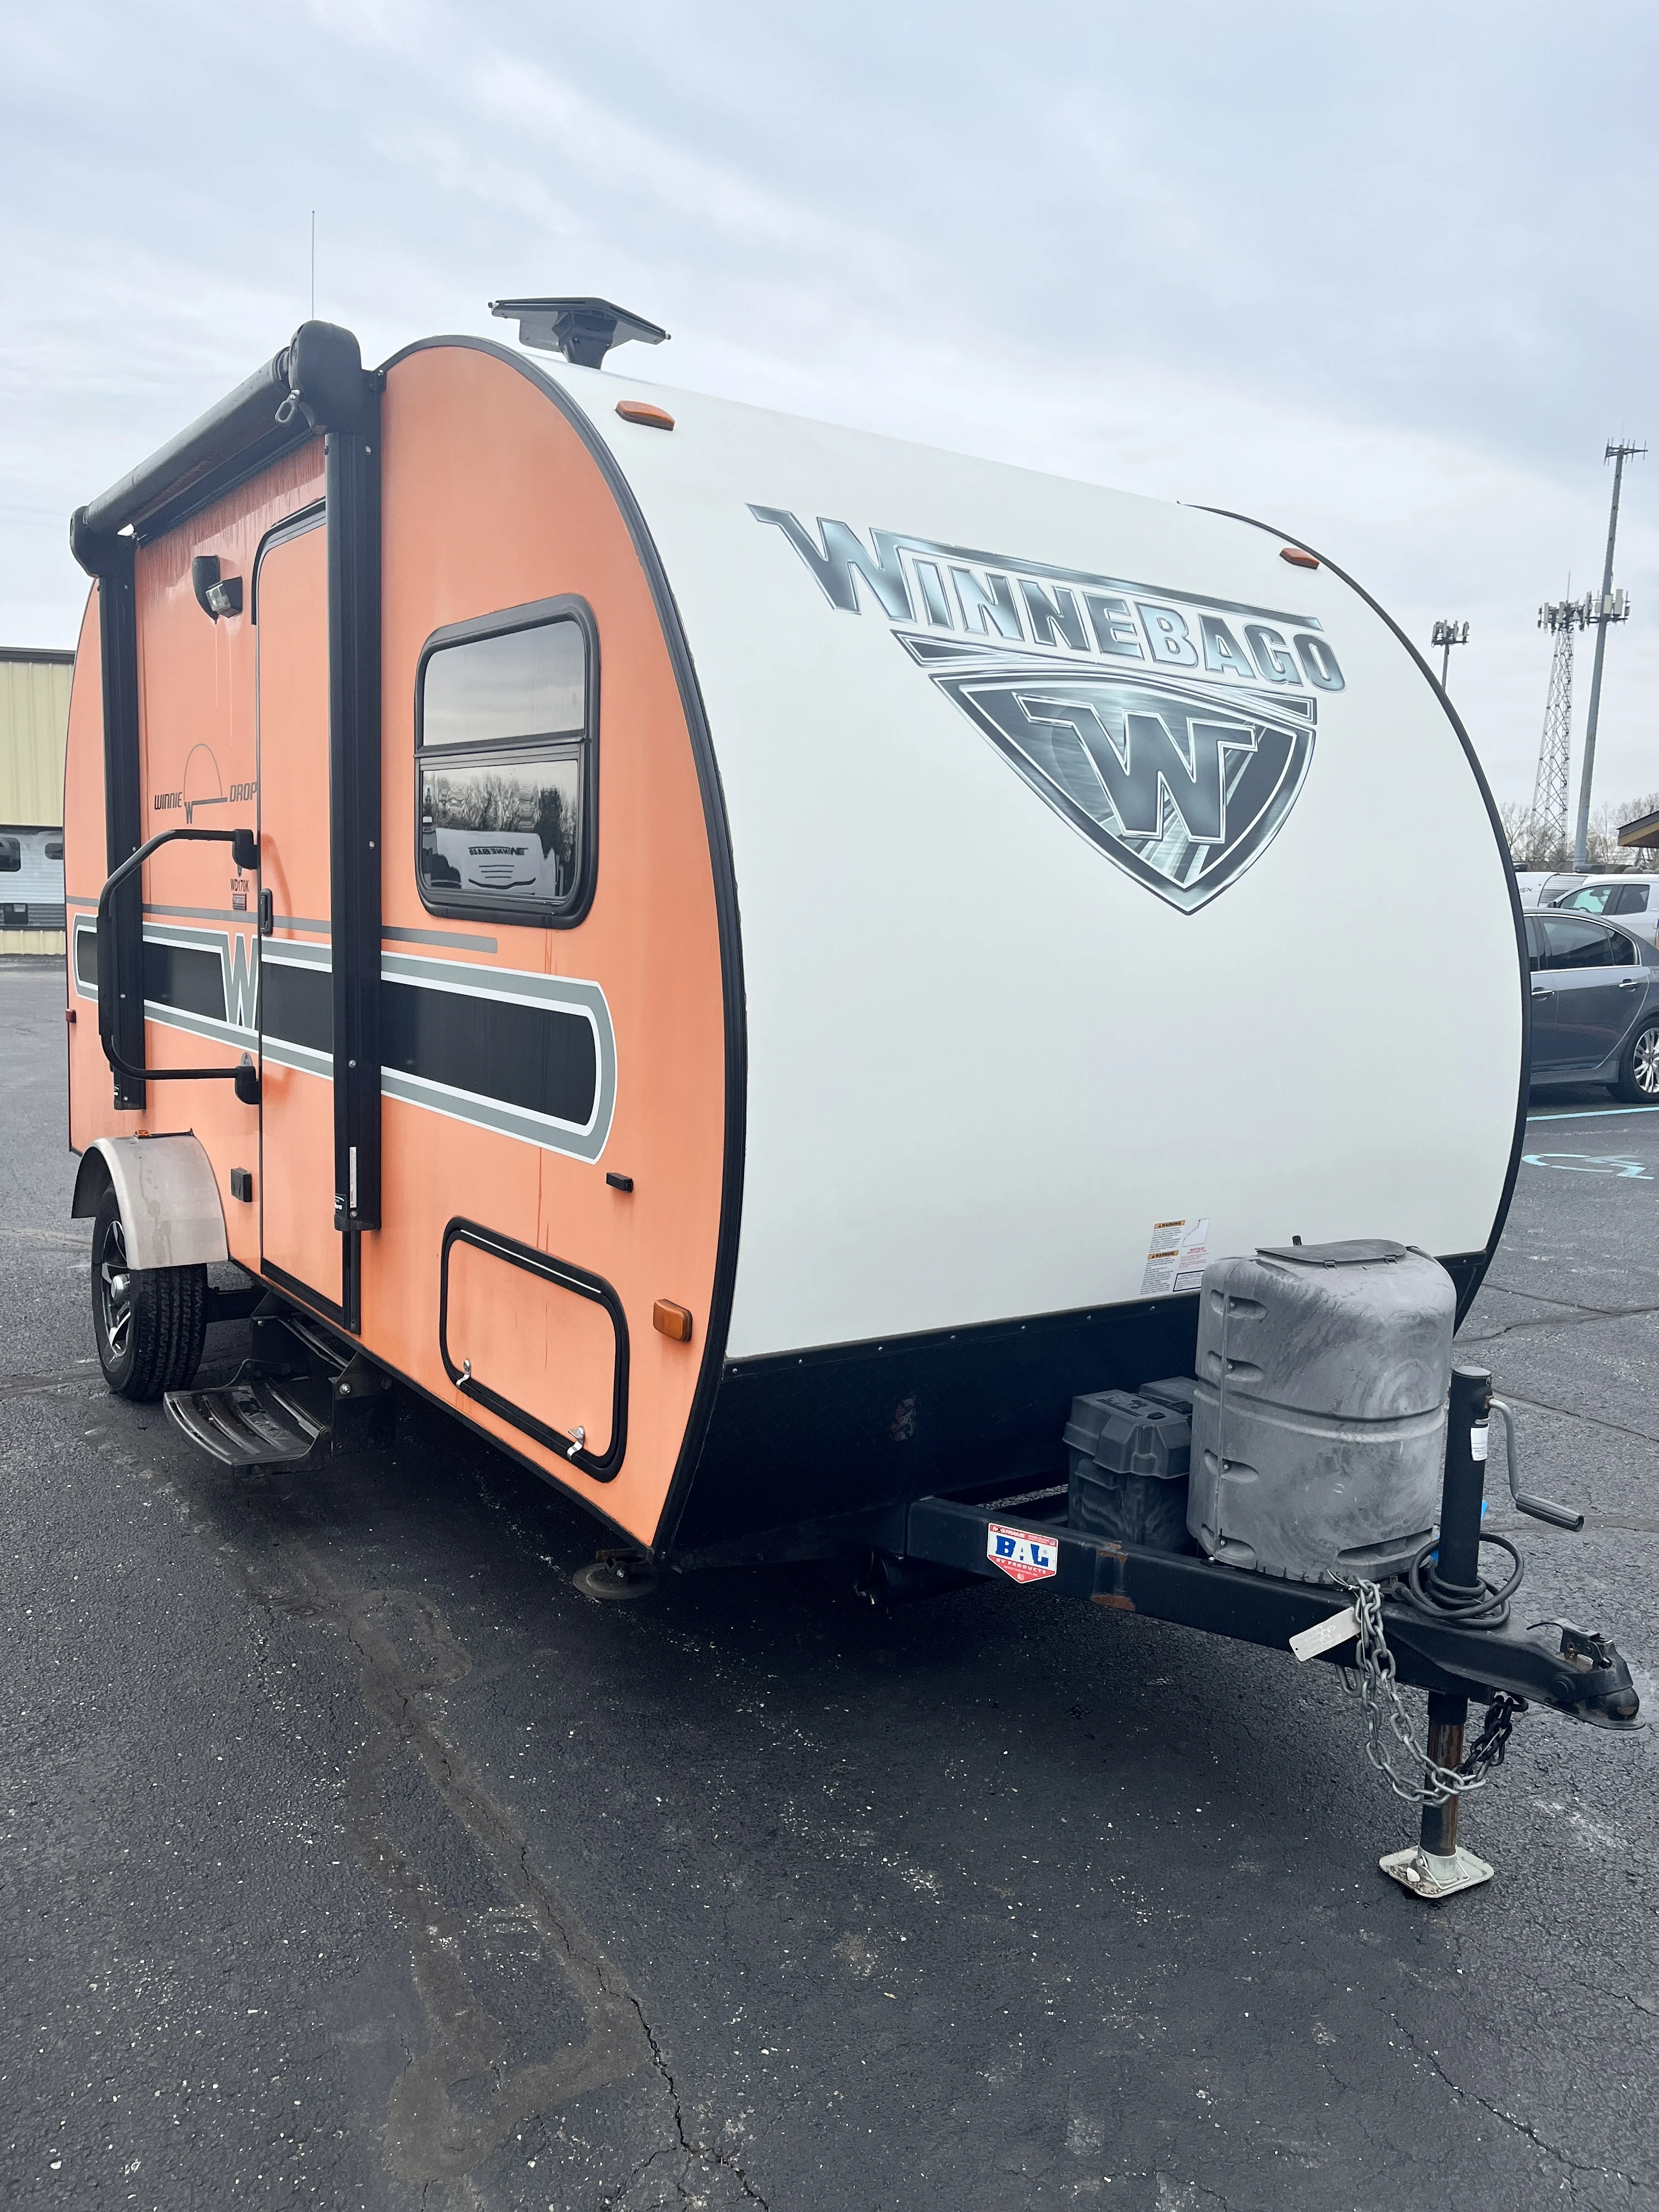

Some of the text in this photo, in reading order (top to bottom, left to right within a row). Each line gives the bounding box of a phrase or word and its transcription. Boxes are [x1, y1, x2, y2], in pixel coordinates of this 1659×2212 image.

[745, 503, 1347, 693] WINNEBAGO
[1012, 691, 1258, 844] W
[154, 782, 257, 810] WINNIE DROP
[996, 1535, 1048, 1567] BAL
[1007, 1560, 1046, 1575] PRODUCTS
